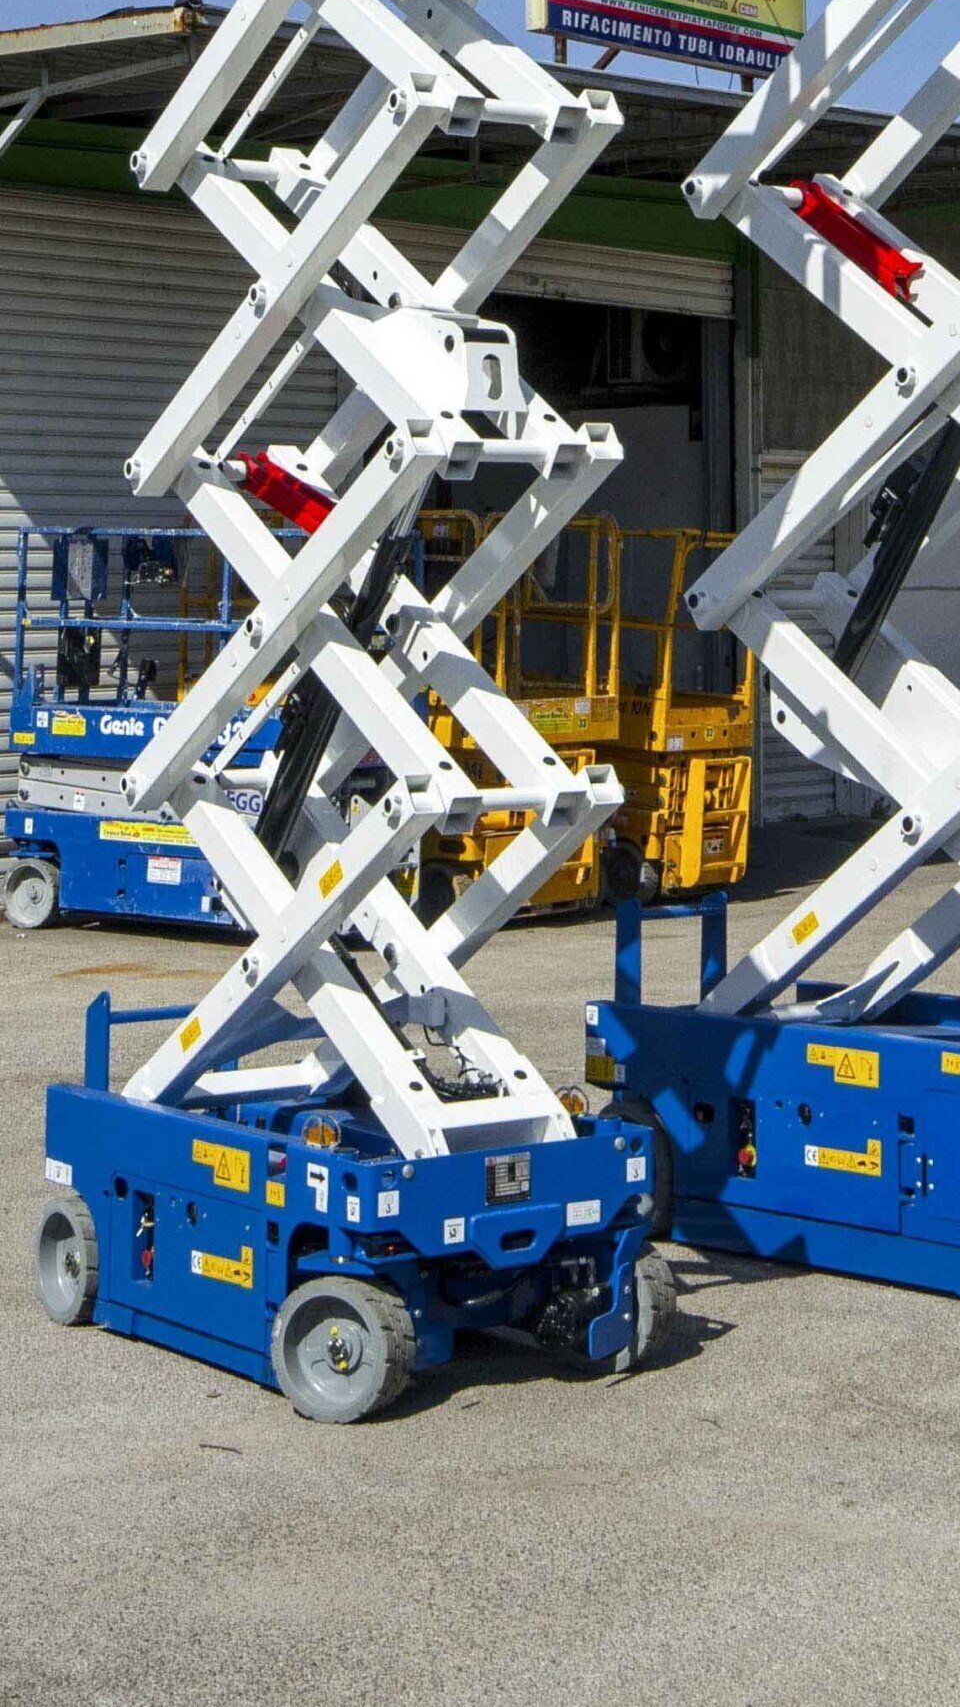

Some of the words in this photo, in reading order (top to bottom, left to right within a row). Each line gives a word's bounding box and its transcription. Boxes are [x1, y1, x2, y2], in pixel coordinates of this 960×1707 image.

[562, 9, 672, 47] RIFACIMENTO
[679, 34, 713, 57] TUBI
[720, 42, 783, 69] IDRAULI
[101, 714, 145, 736] Genie
